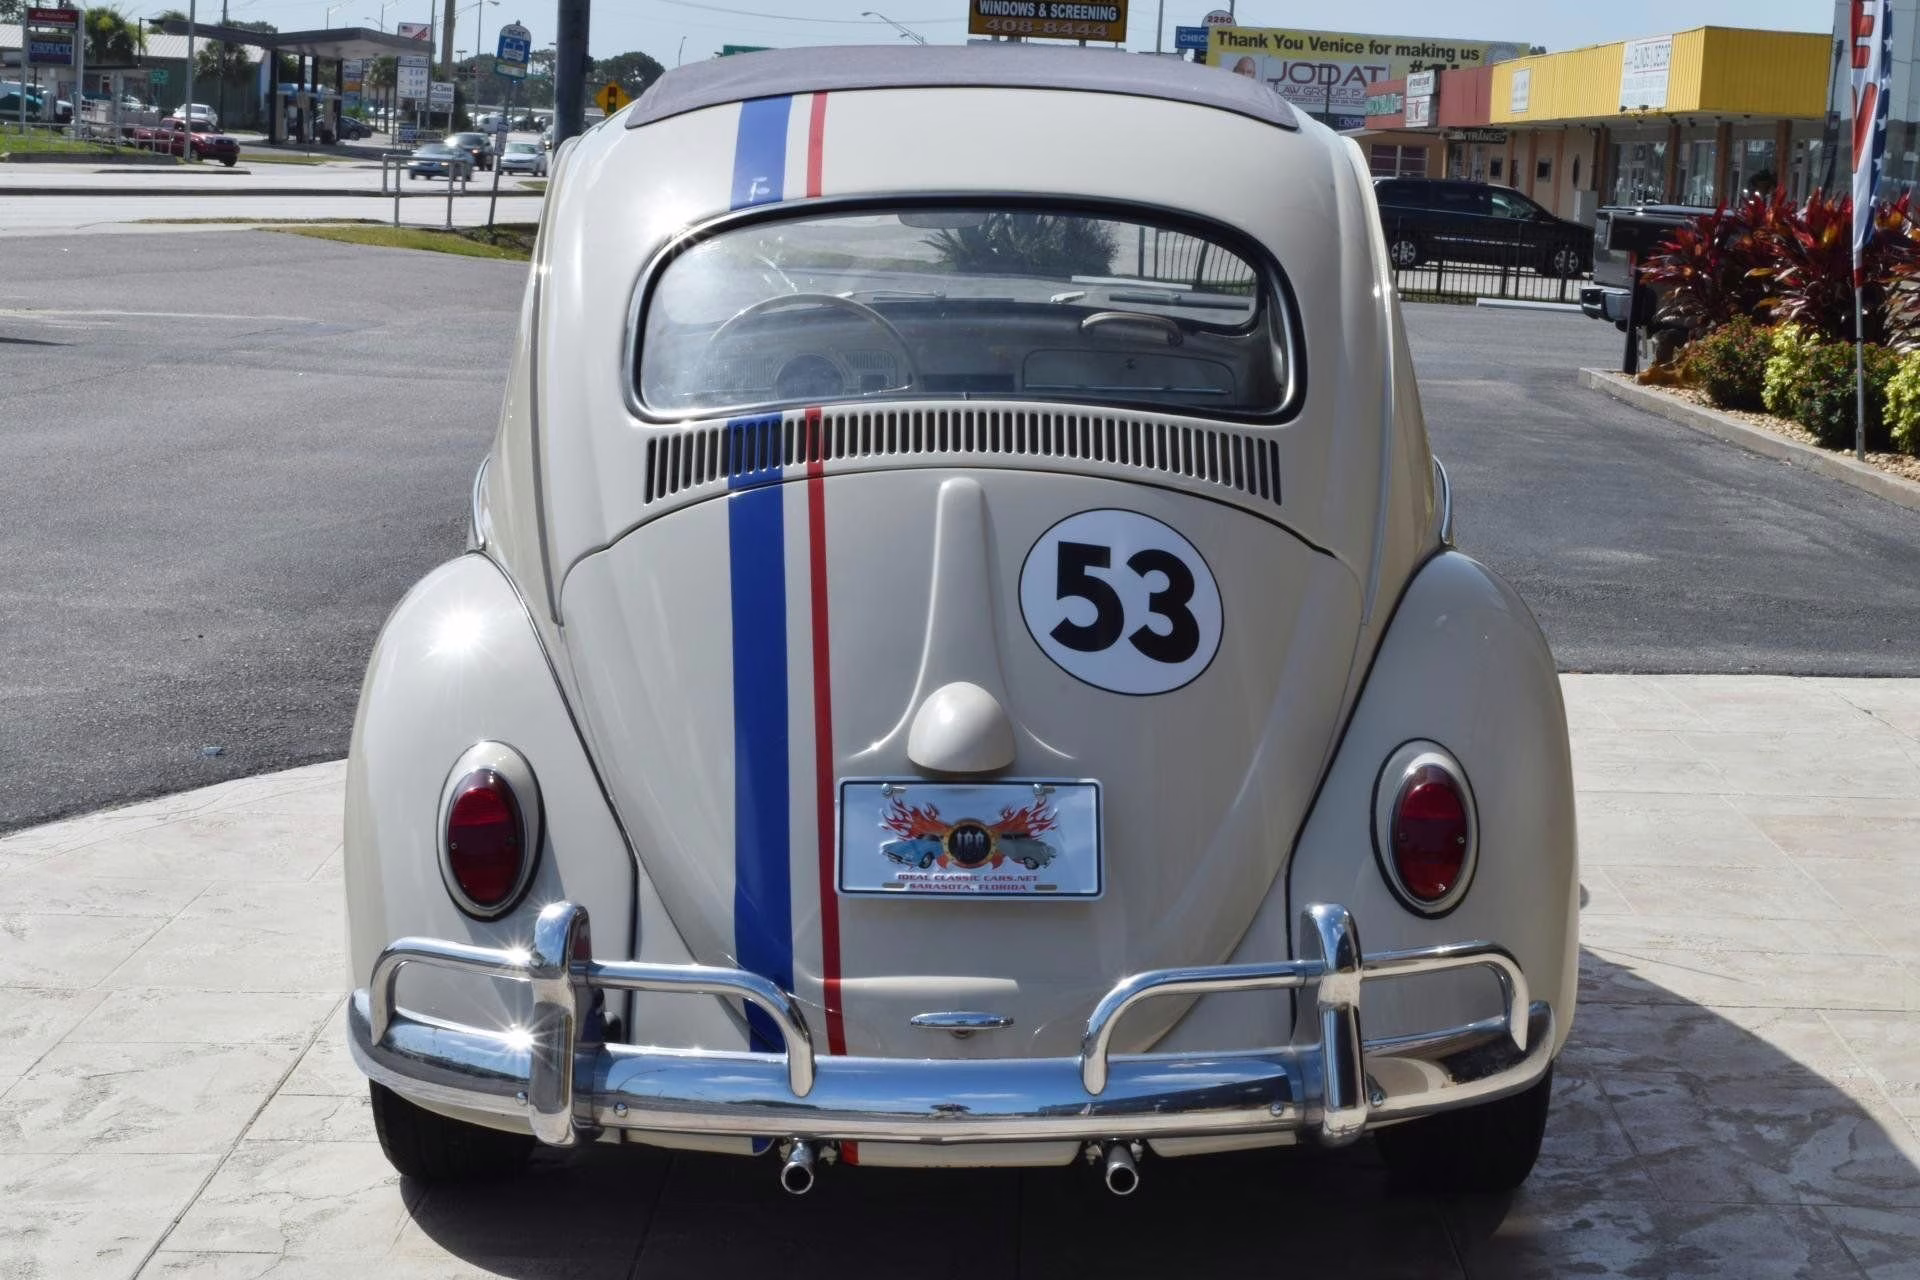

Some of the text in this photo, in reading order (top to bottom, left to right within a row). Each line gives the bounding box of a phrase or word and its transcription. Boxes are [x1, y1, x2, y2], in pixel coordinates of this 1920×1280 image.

[979, 0, 1117, 21] WINDOWS & SCREENING
[985, 18, 1109, 37] 408-8444
[1217, 31, 1480, 62] Thank You Venice for making us
[1267, 61, 1386, 87] JODAT
[1049, 540, 1200, 664] 53
[934, 874, 980, 882] CLASSIC
